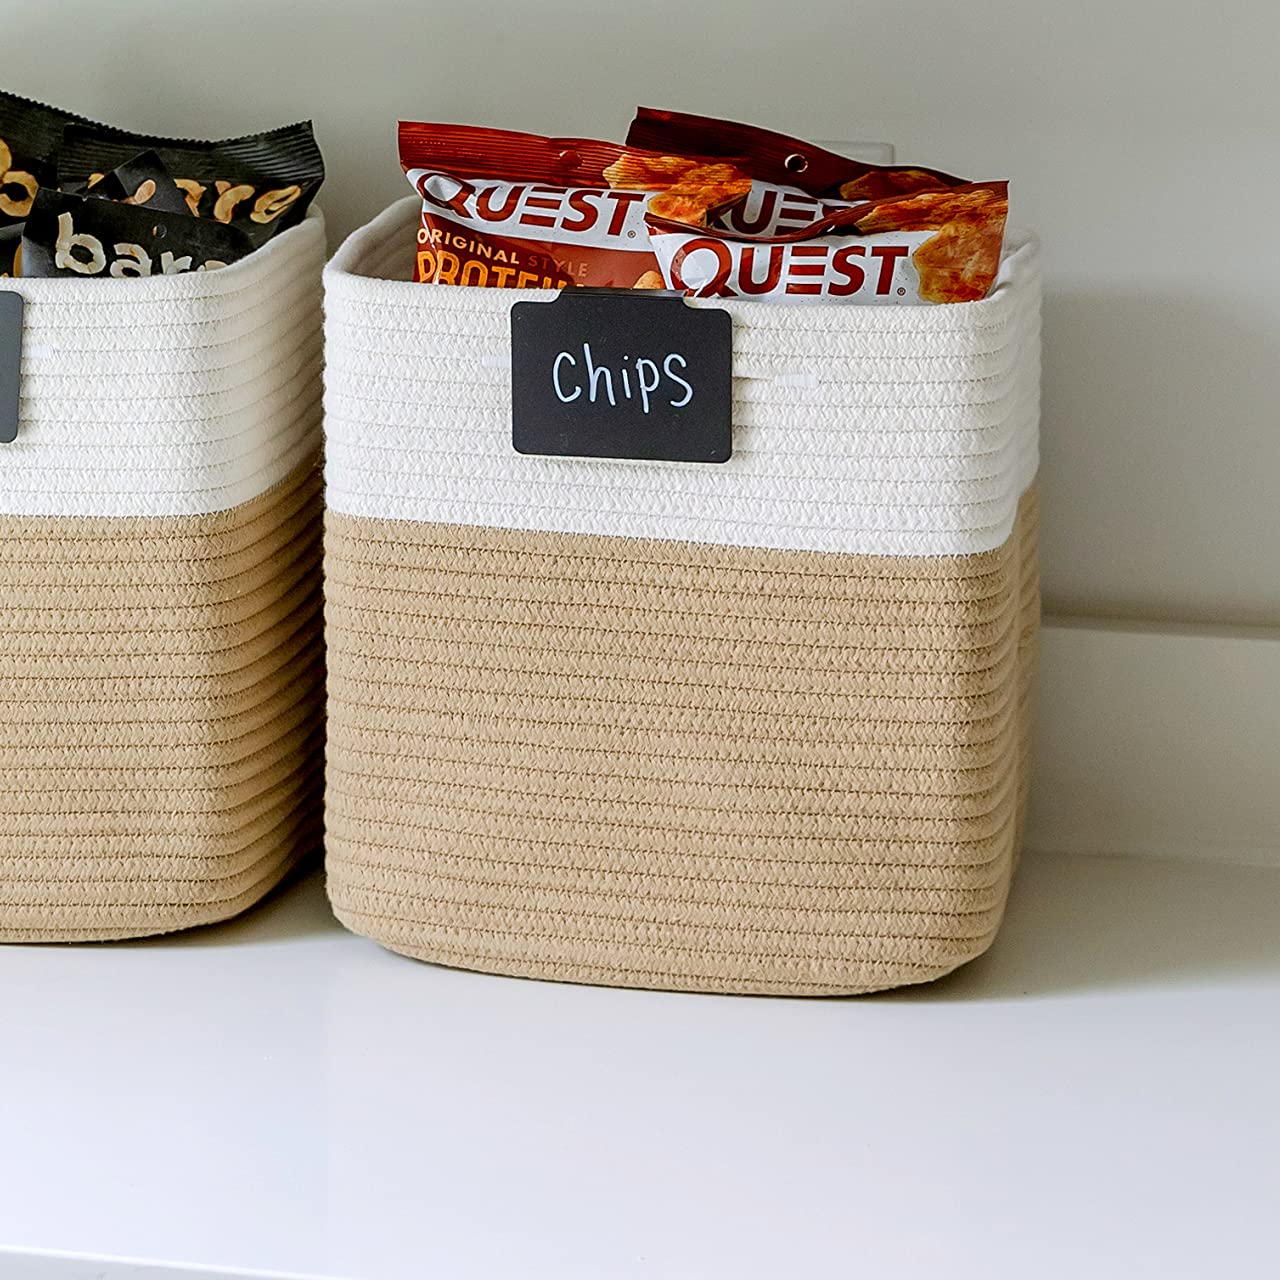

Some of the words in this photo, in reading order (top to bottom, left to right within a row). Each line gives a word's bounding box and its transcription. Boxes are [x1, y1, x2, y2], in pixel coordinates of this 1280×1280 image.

[417, 172, 645, 237] QUEST
[55, 211, 227, 278] bar
[417, 228, 520, 265] ORIGINAL
[528, 254, 589, 278] STYLE
[670, 237, 909, 298] QUEST
[551, 342, 695, 414] Chips
